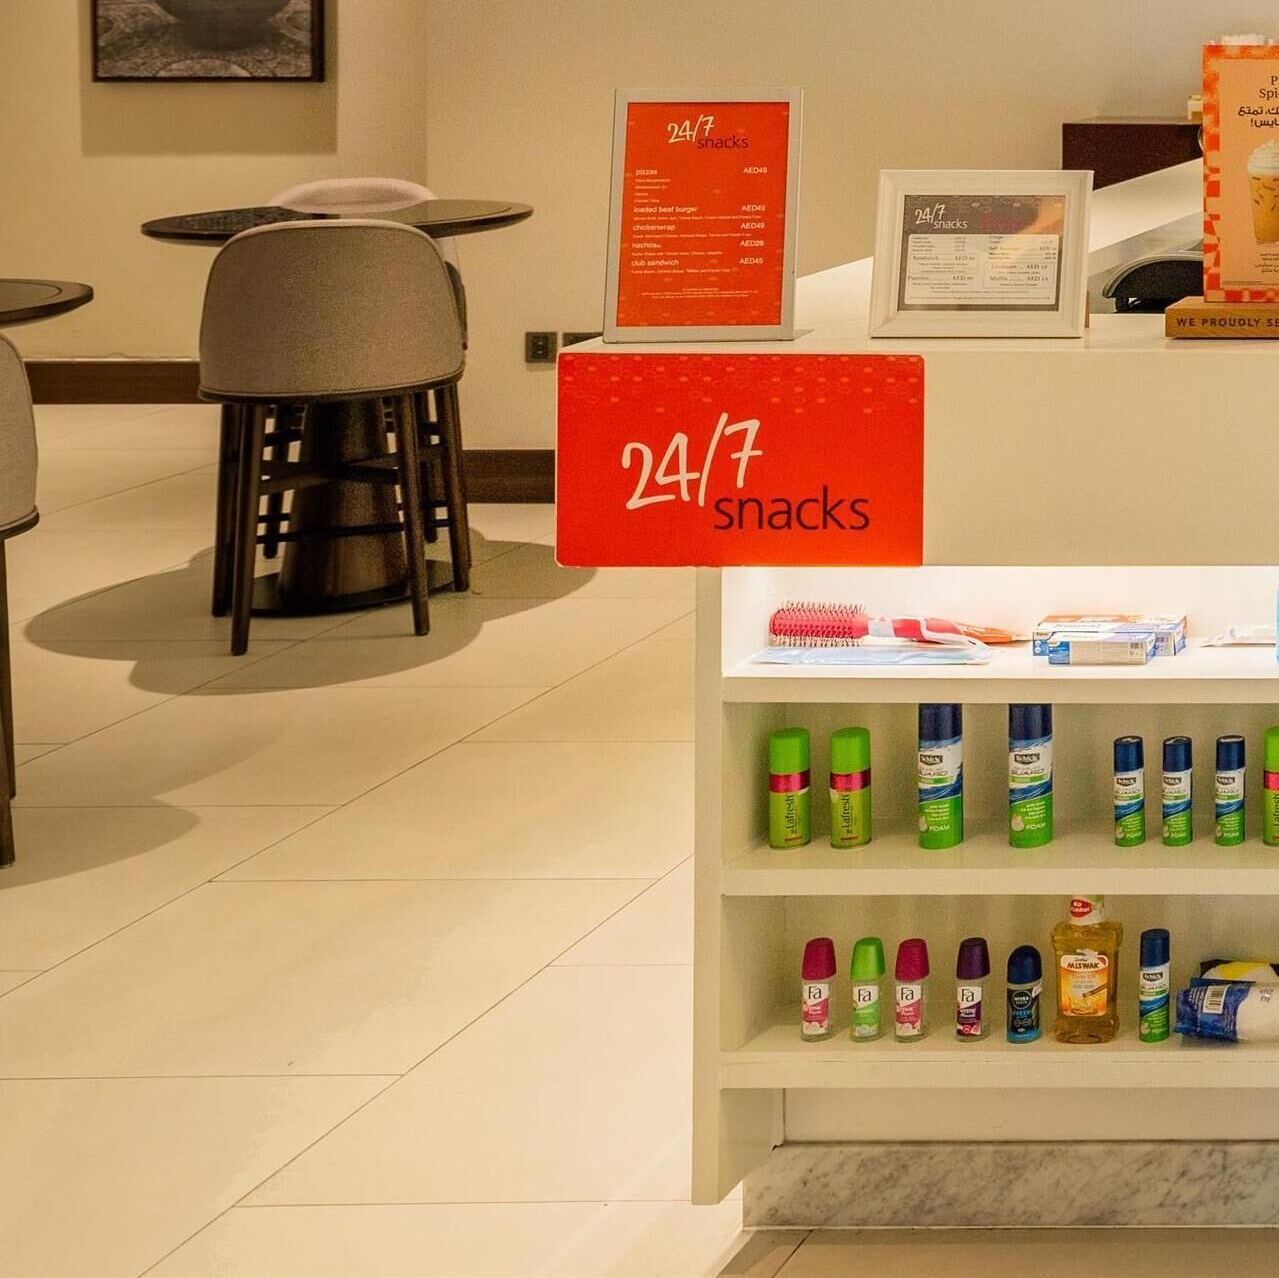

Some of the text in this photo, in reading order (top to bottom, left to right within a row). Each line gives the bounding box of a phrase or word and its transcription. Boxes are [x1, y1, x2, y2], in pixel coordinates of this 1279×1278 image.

[667, 114, 715, 144] 24/7
[697, 134, 750, 150] snacks
[915, 203, 946, 225] 24/7
[933, 219, 968, 230] snacks
[1175, 317, 1196, 327] WE
[1201, 317, 1261, 328] PROUDLY
[622, 412, 763, 510] 24/7
[713, 485, 871, 532] snacks
[808, 986, 822, 1000] Fa
[857, 989, 872, 1003] Fa
[900, 986, 914, 1001] Fa
[961, 988, 975, 1003] Fa
